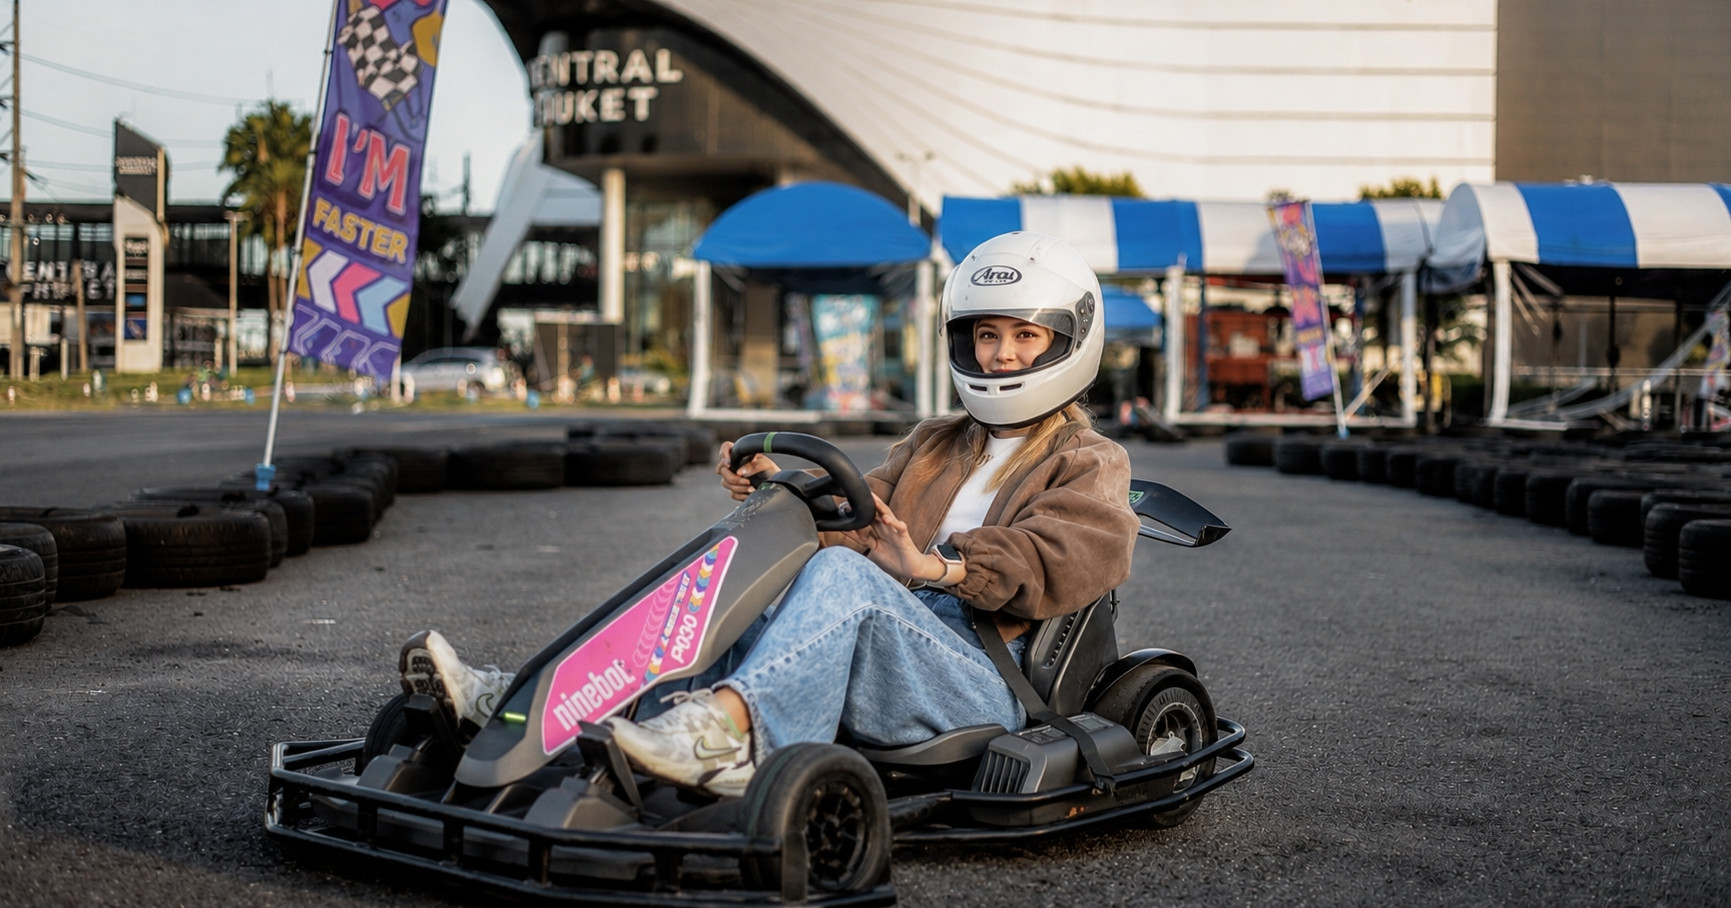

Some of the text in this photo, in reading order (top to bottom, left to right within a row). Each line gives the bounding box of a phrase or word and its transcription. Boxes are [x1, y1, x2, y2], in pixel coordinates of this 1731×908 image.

[325, 113, 411, 215] I'M
[312, 197, 408, 264] FASTER
[975, 267, 1015, 282] Arai
[552, 658, 637, 732] ninebot
